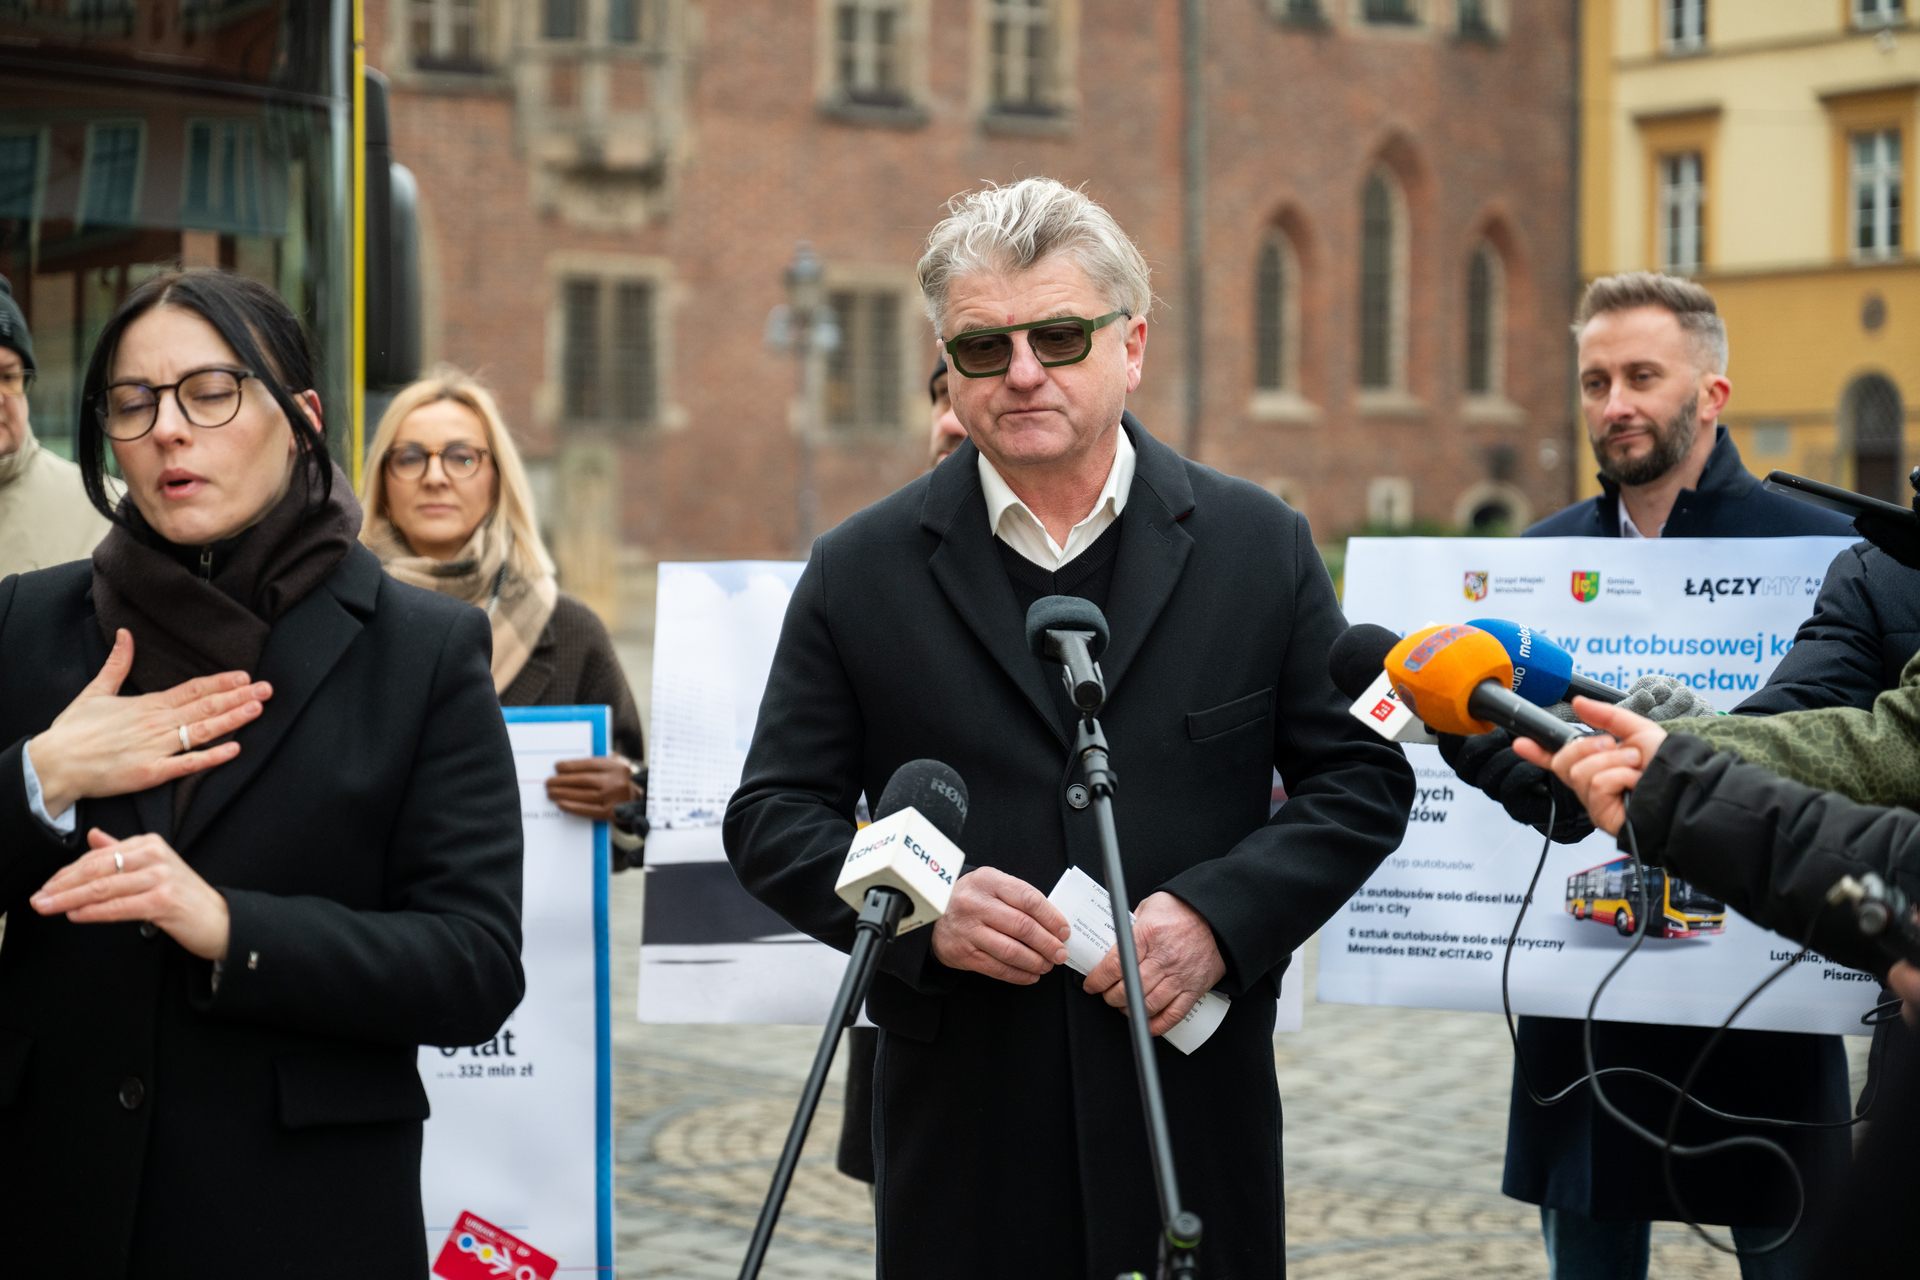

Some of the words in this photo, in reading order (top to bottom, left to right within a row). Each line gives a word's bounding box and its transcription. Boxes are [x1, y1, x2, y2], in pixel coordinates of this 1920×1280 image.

[1586, 631, 1763, 664] autobusowej
[1408, 806, 1447, 822] dów
[848, 833, 897, 863] ECHO24
[903, 835, 954, 885] ECHO24
[1367, 888, 1434, 900] autobusów
[1437, 892, 1462, 902] solo
[1465, 891, 1502, 904] diesel
[1350, 901, 1385, 913] Lion's
[1387, 902, 1412, 918] City
[1358, 929, 1389, 941] sztuk
[1392, 931, 1460, 944] autobusów
[1463, 934, 1488, 946] solo
[1347, 943, 1405, 956] Mercedes
[1408, 946, 1438, 958] BENZ
